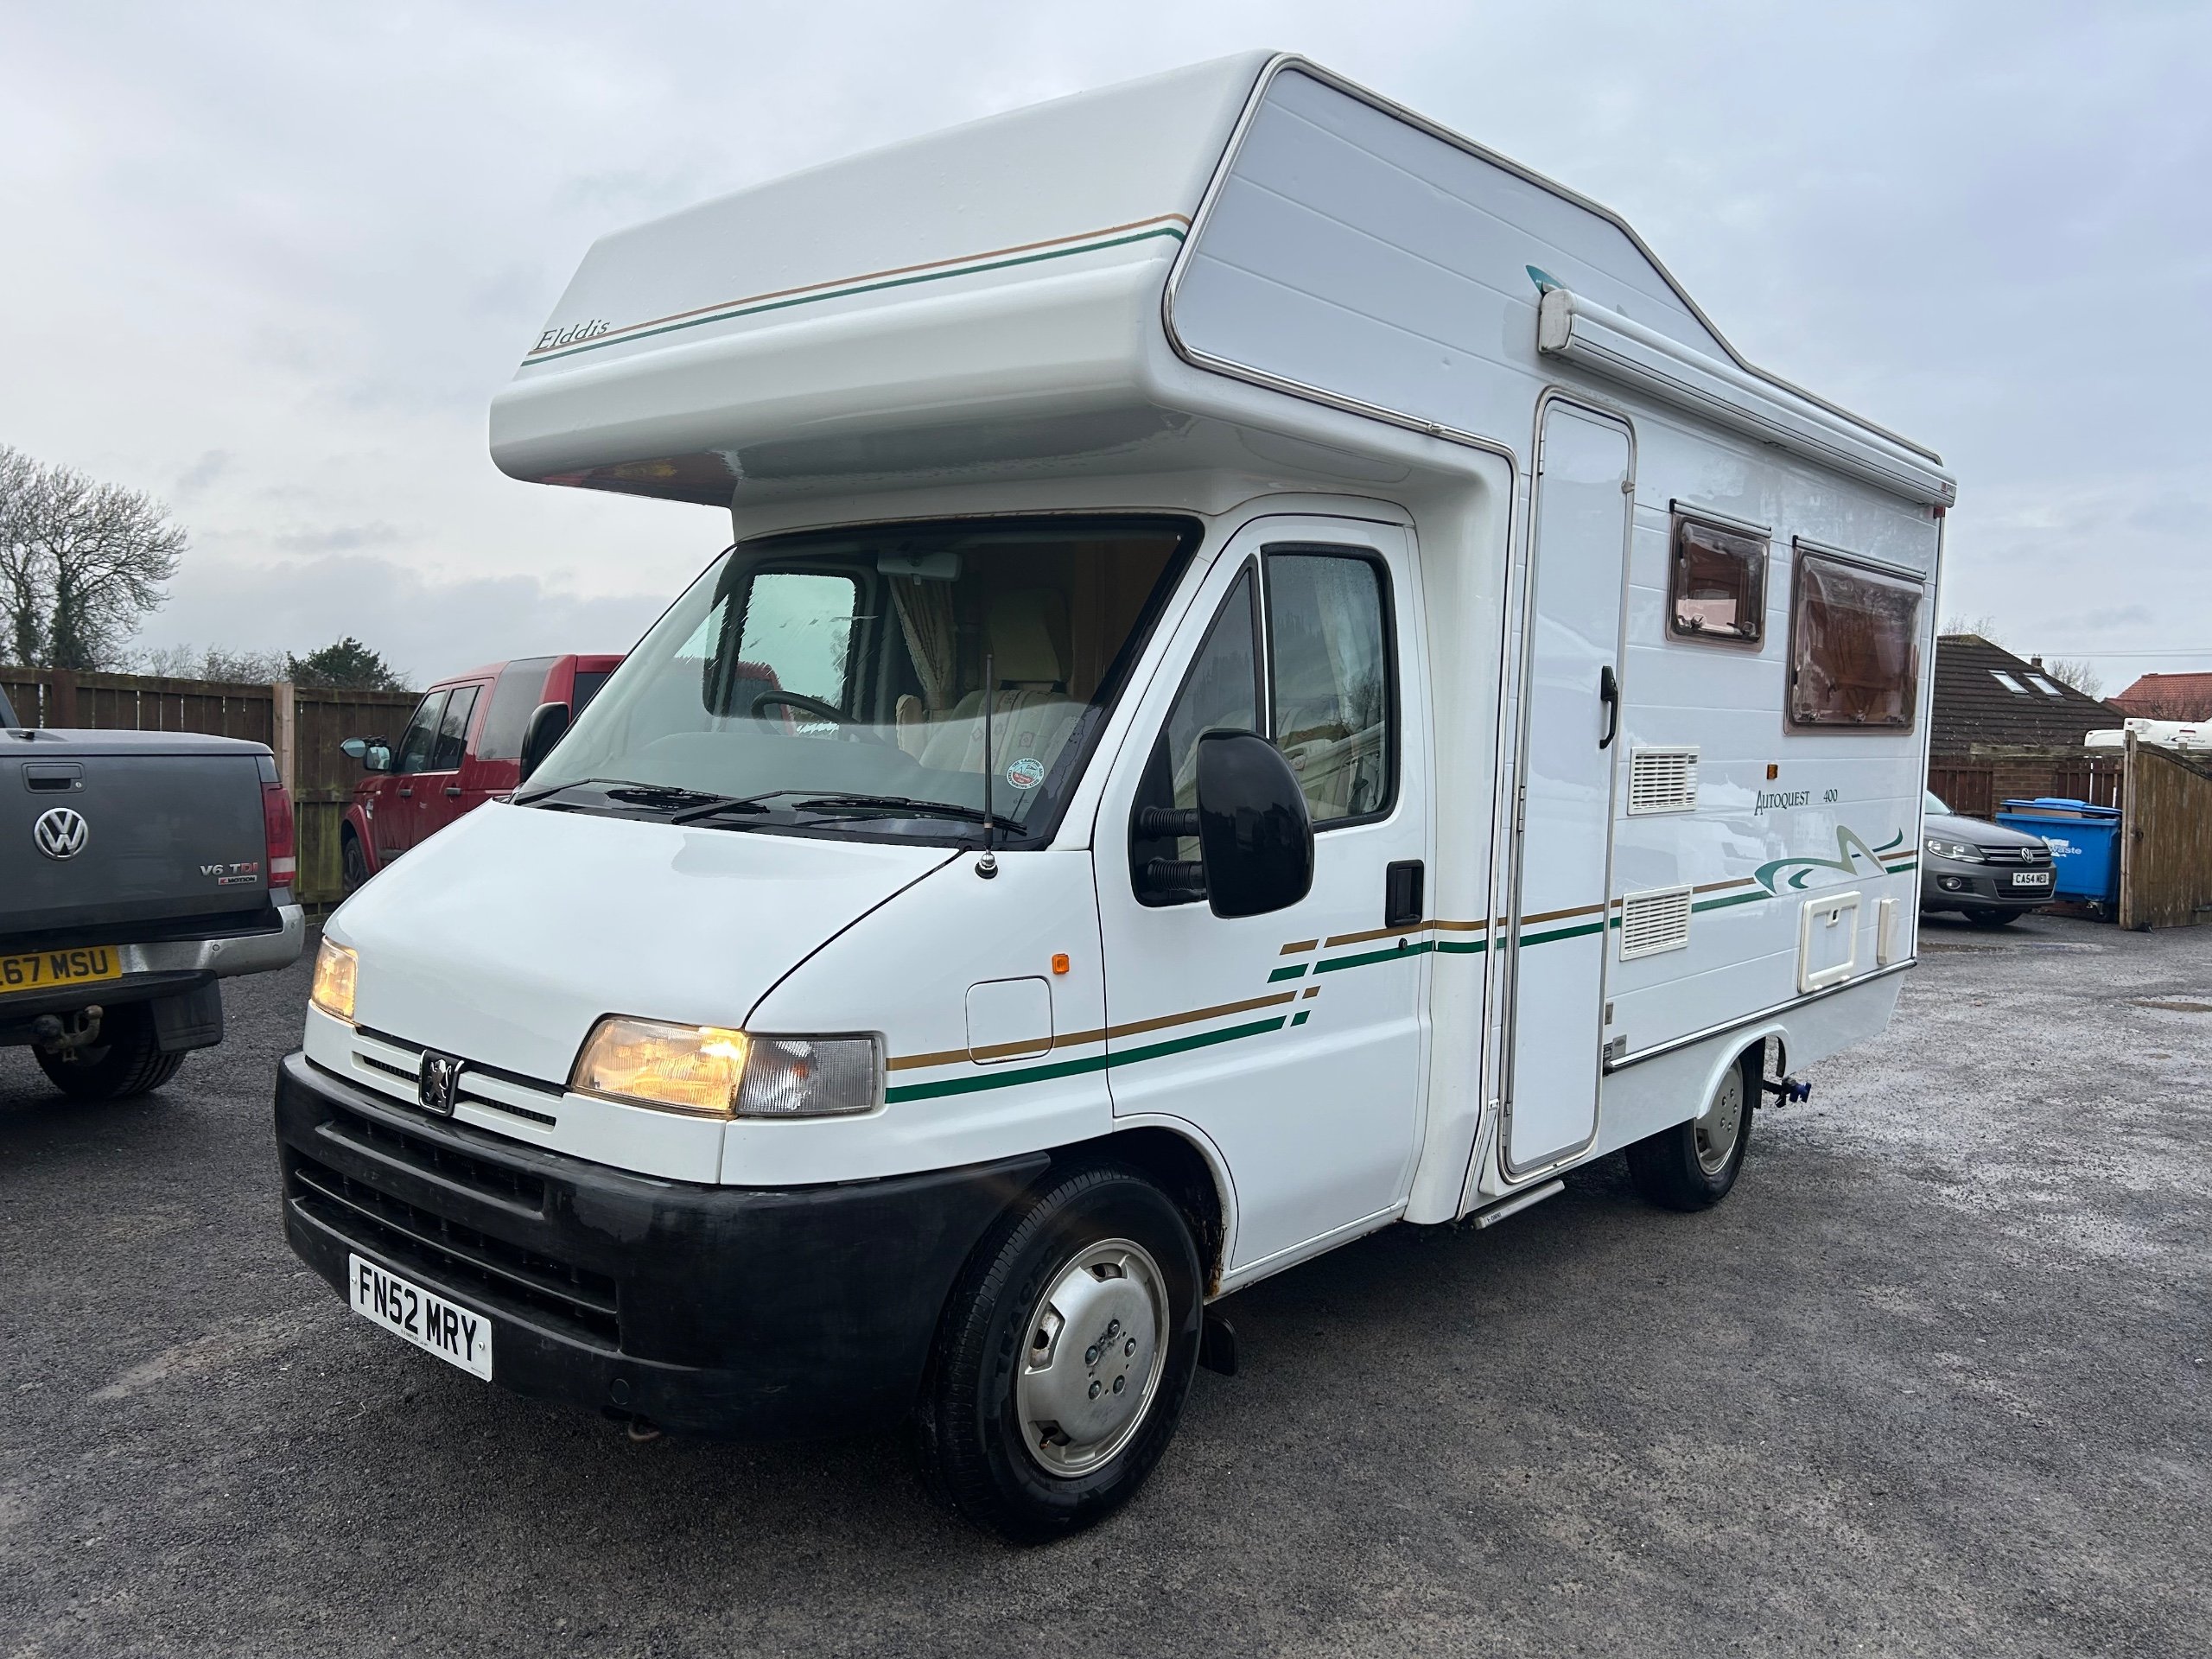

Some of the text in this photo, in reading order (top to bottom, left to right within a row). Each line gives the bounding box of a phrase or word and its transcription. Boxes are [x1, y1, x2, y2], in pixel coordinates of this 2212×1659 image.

[533, 319, 610, 352] Elddis
[1823, 789, 1838, 802] 400
[200, 862, 258, 876] V6 TDI
[2016, 874, 2035, 883] CA54
[0, 950, 109, 986] 67 MSU
[359, 1263, 477, 1362] FN52 MRY
